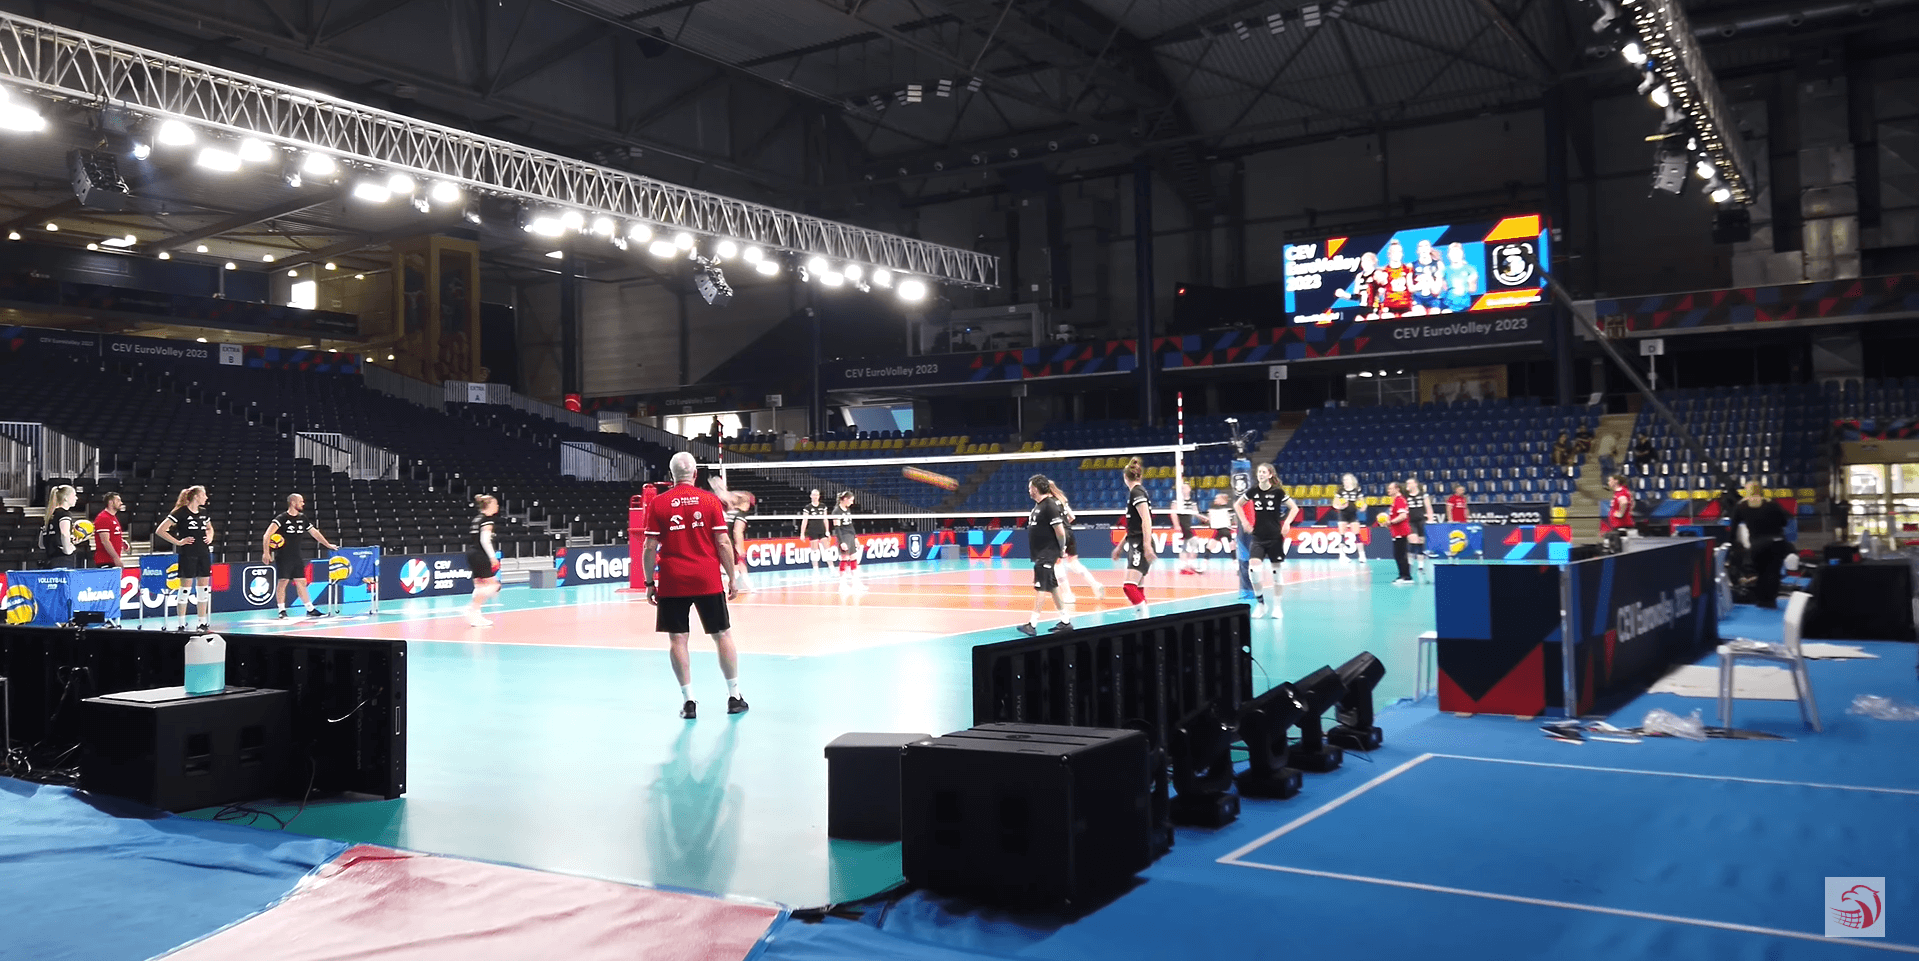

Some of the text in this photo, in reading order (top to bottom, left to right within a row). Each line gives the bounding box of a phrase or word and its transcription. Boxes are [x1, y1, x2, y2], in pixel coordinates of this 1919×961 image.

[1285, 244, 1317, 261] CEV
[1285, 255, 1360, 276] EuroVolley
[1286, 274, 1322, 292] 2023
[1393, 318, 1528, 340] CEV EuroVolley 2023
[111, 342, 208, 359] CEV EuroVolley 2023
[845, 364, 939, 379] CEV EuroVolley 2023
[1510, 512, 1541, 523] 2023
[746, 543, 783, 567] CEV
[866, 537, 901, 560] 2023
[1297, 531, 1358, 555] 2023
[434, 560, 452, 570] CEV
[1617, 603, 1636, 643] CEV
